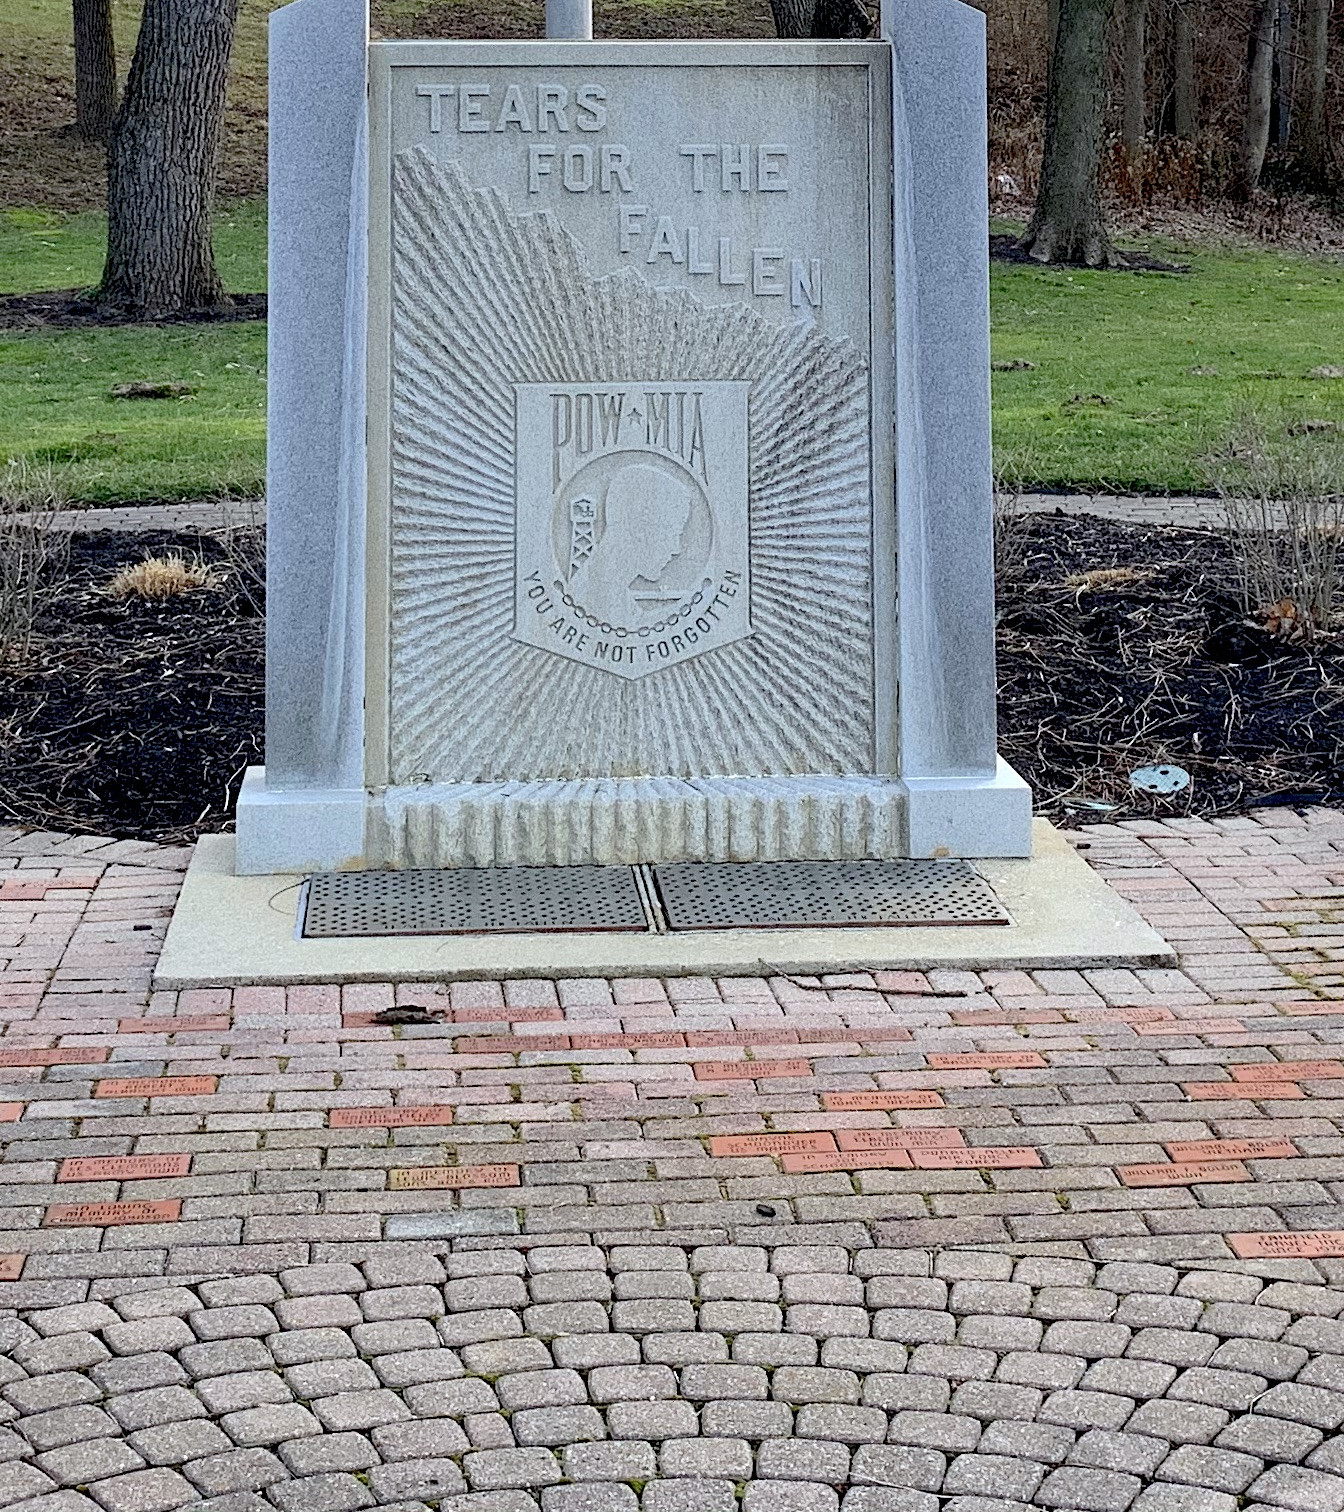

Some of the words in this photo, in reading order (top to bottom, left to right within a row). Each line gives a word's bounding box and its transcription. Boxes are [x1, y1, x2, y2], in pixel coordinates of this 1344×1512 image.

[416, 83, 609, 134] TEARS
[528, 143, 634, 194] FOR
[680, 143, 792, 194] THE
[619, 204, 824, 309] FALLEN
[549, 392, 626, 495] POW
[643, 391, 709, 487] MIA
[522, 570, 552, 615] YOU
[549, 613, 588, 652] ARE
[594, 641, 636, 664] NOT
[645, 569, 743, 663] FORGOTTEN
